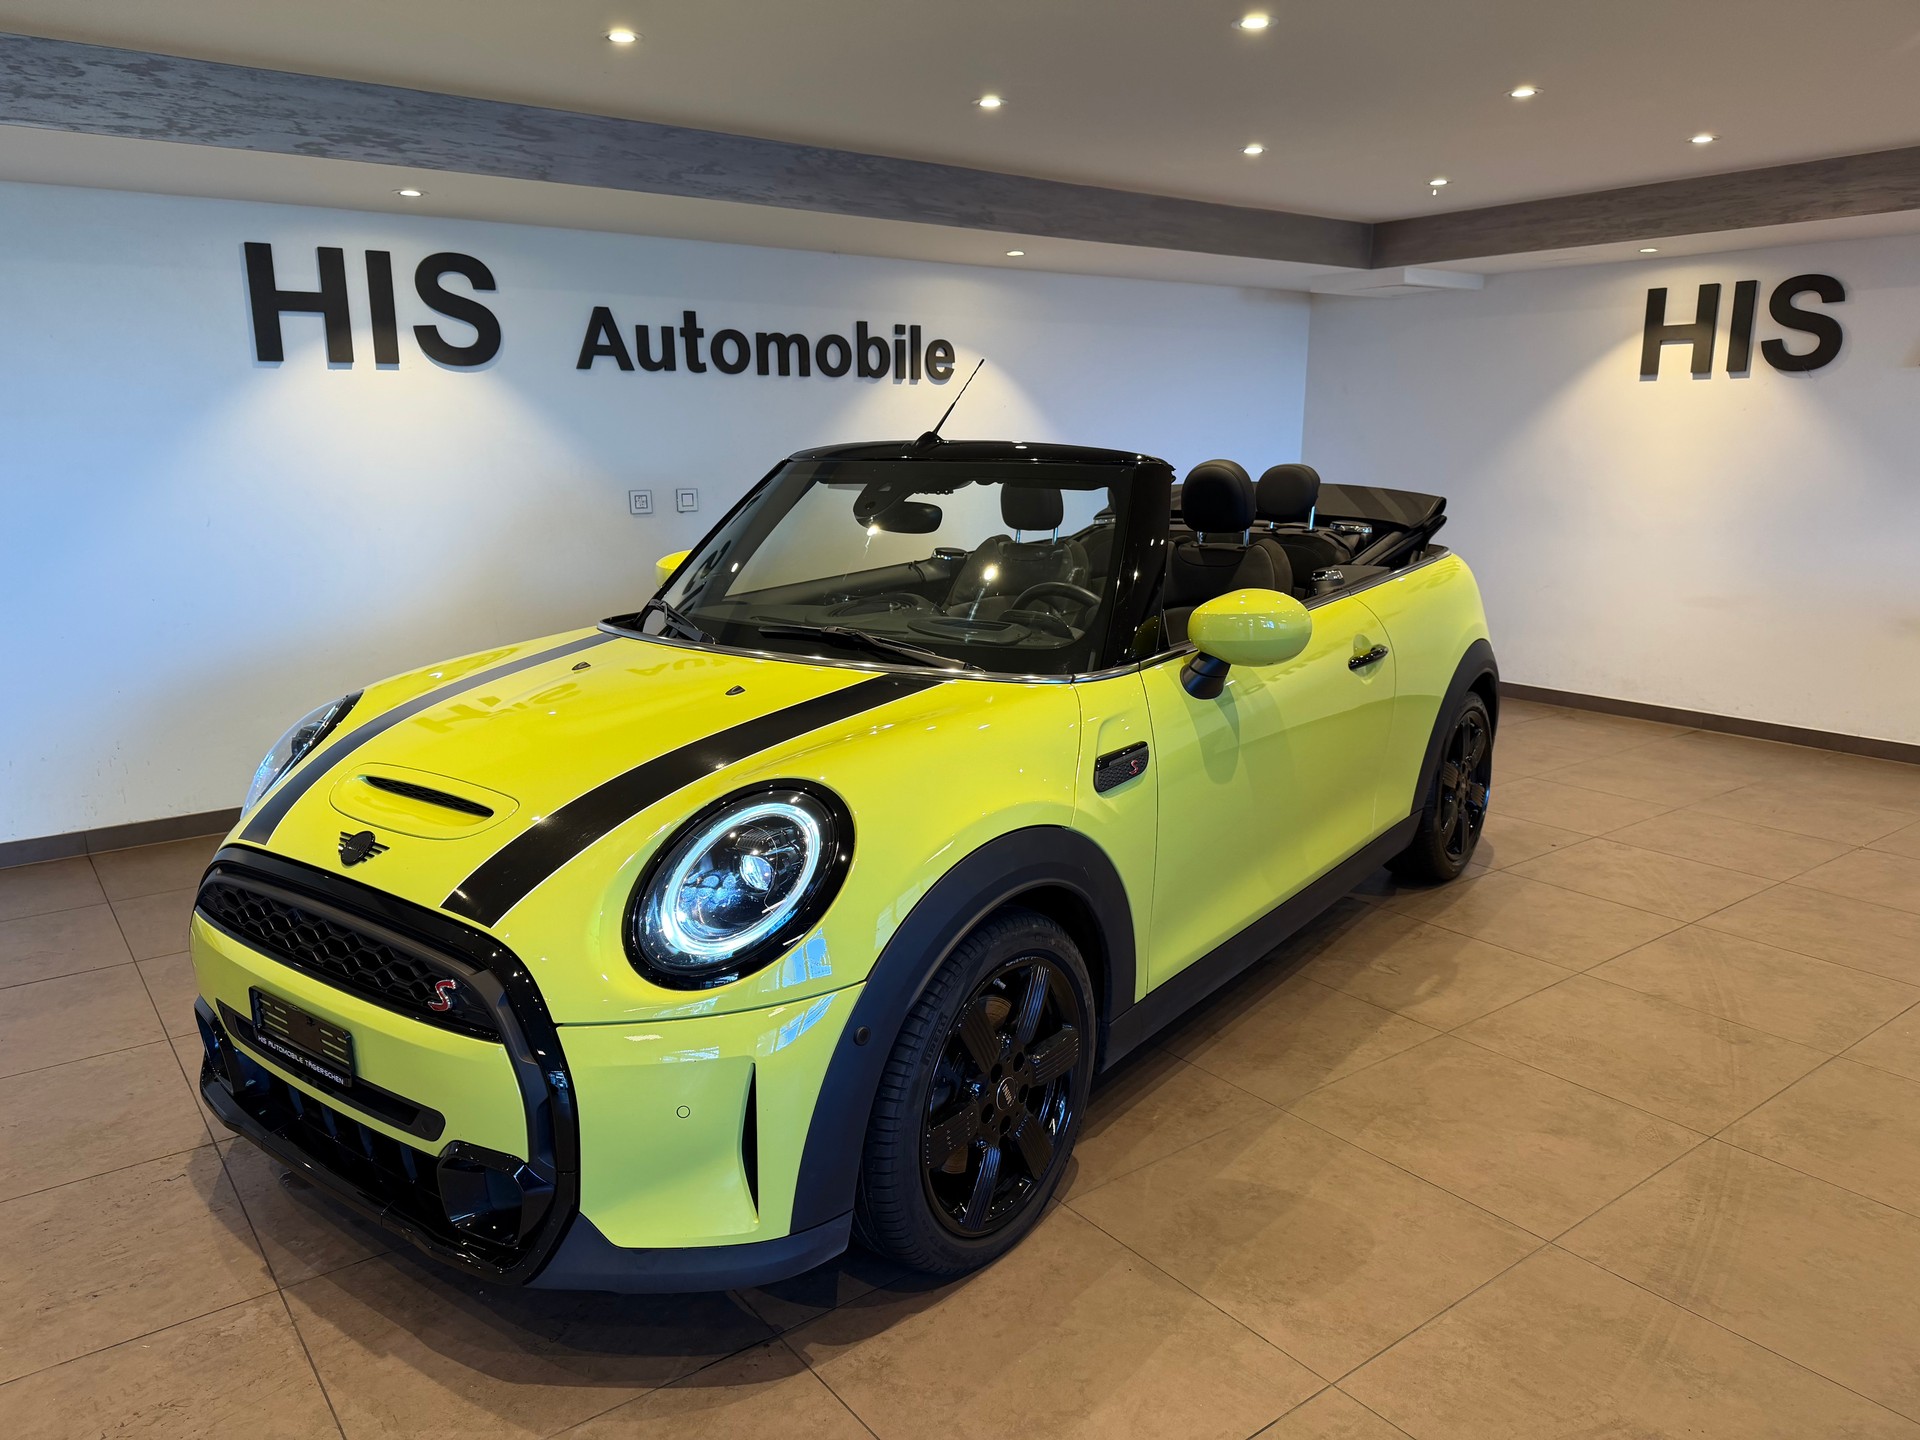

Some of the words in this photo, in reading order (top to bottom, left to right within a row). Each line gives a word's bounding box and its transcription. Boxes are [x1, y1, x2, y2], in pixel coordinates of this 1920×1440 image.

[244, 242, 500, 366] HIS
[576, 306, 956, 380] Automobile
[1639, 274, 1846, 374] HIS
[1129, 760, 1139, 775] S
[428, 979, 456, 1011] S
[257, 1035, 267, 1045] HIS
[268, 1040, 303, 1064] AUTOMOBILE
